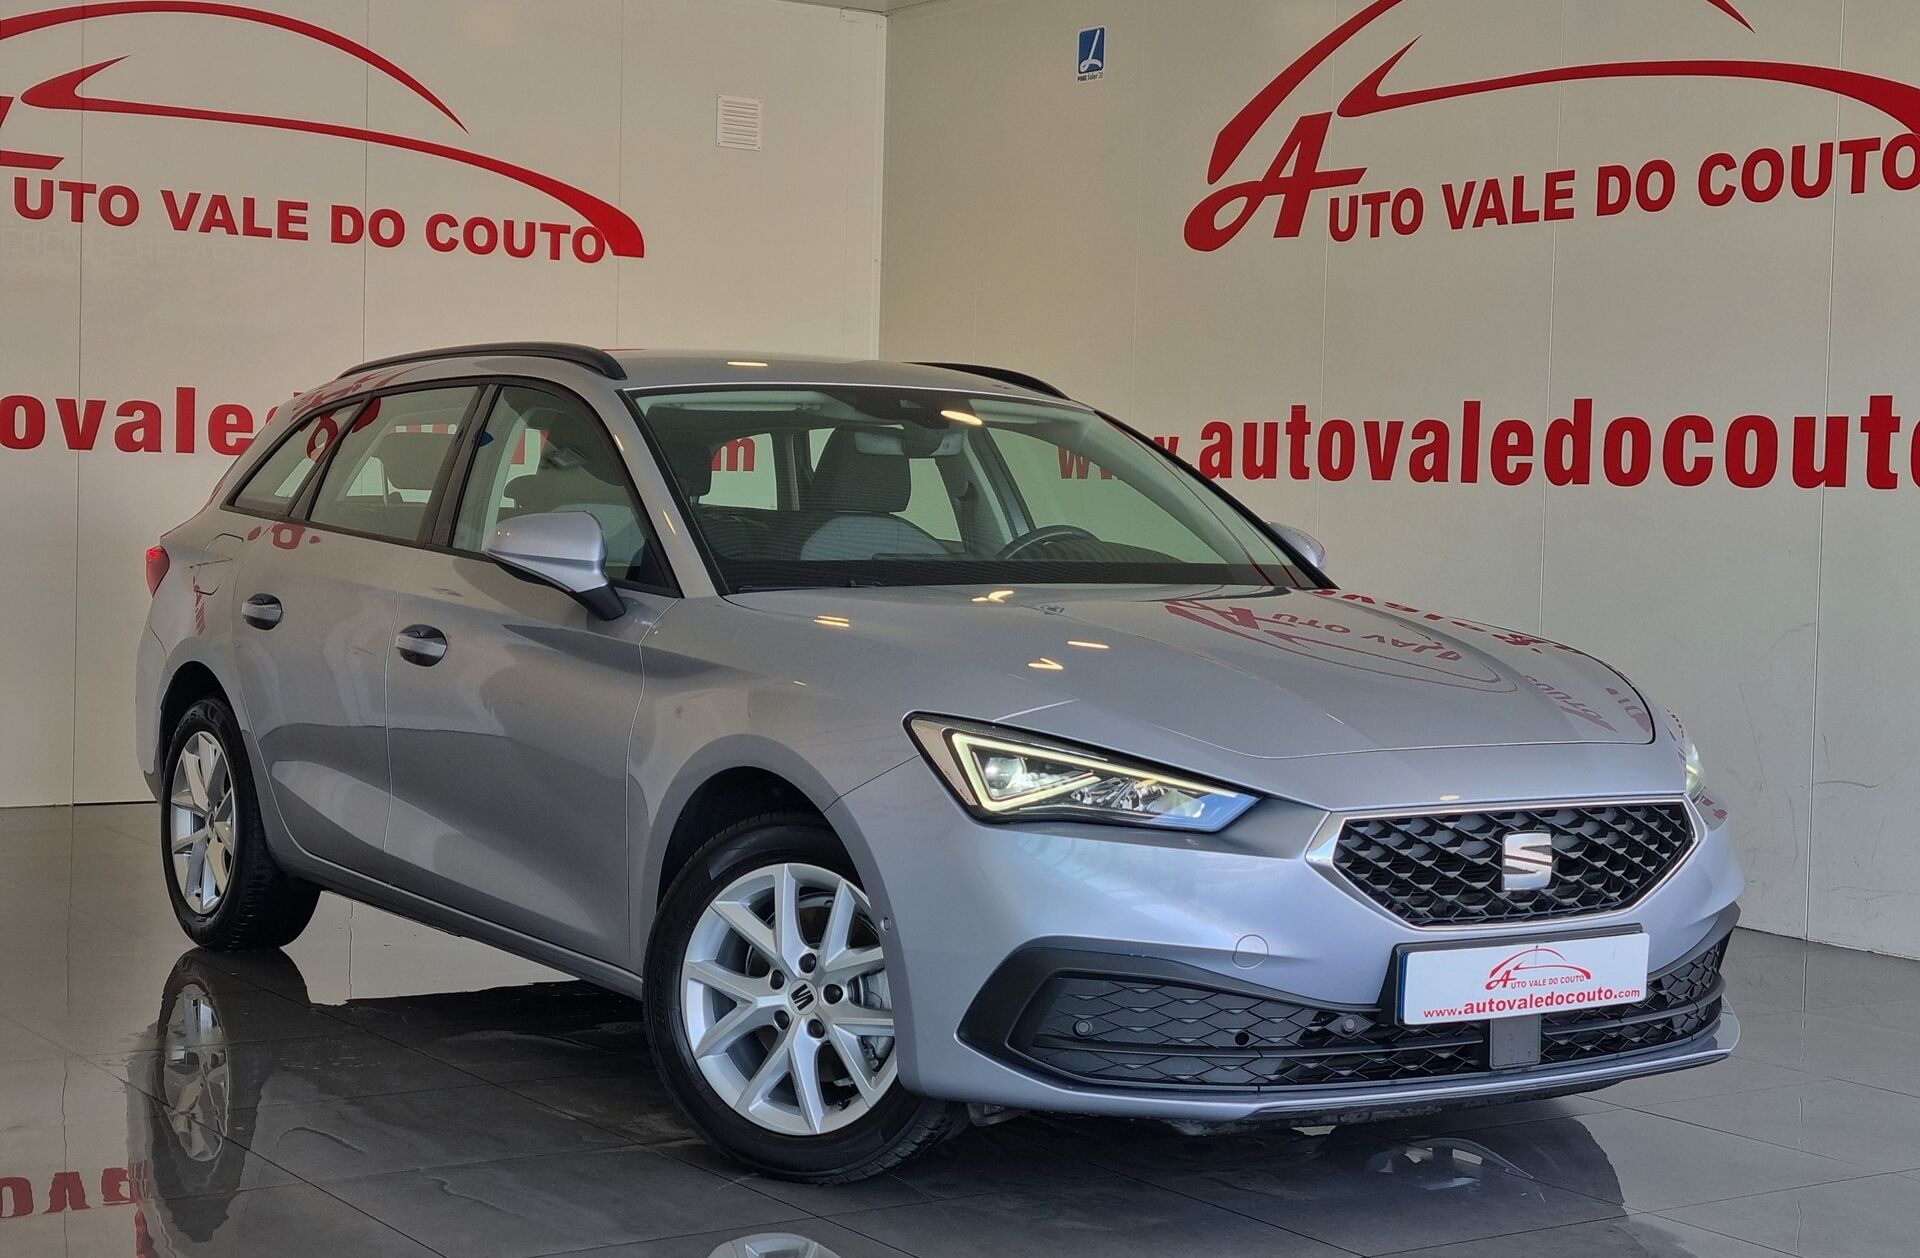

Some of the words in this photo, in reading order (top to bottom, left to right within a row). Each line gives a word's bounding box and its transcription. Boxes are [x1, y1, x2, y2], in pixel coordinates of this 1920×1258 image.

[0, 150, 139, 227] UTO
[160, 190, 308, 241] VALE
[331, 204, 406, 247] DO
[425, 213, 606, 263] COUTO
[1184, 112, 1424, 251] AUTO
[1442, 170, 1576, 229] VALE
[1597, 159, 1676, 217] DO
[1698, 133, 1920, 207] COUTO
[0, 387, 278, 456] ovale
[1424, 986, 1640, 1018] www.autovaledocouto.com
[1485, 969, 1526, 990] AUTO
[1529, 979, 1546, 987] VALE
[1549, 977, 1559, 985] DO
[1560, 974, 1585, 984] COUTO
